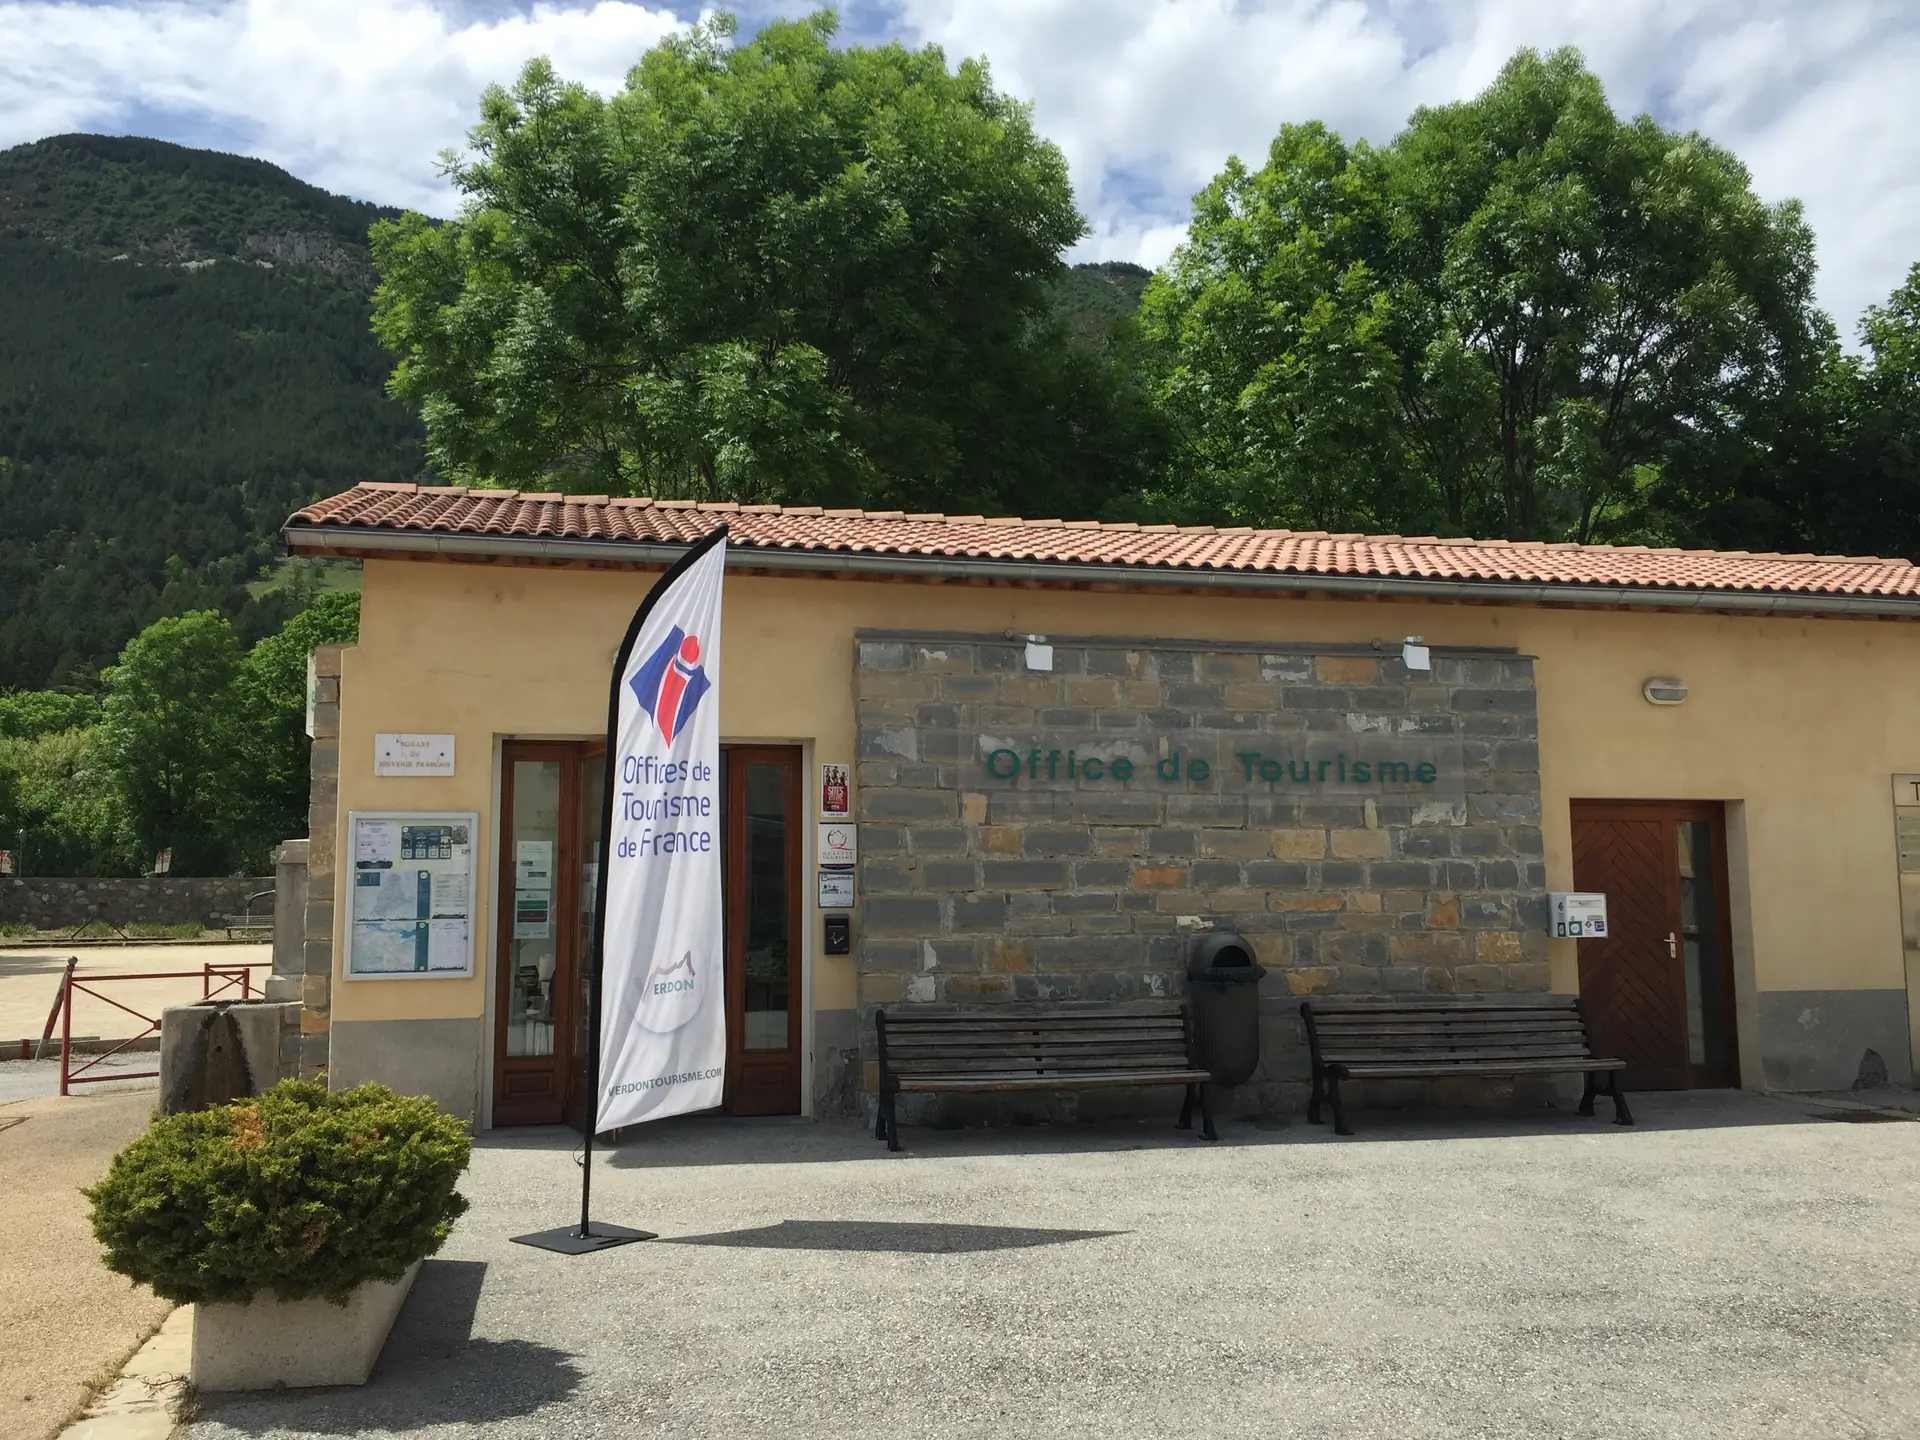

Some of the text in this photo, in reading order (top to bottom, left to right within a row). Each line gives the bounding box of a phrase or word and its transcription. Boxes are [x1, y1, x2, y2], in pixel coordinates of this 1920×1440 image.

[623, 755, 711, 785] Offices de
[987, 749, 1438, 784] Office de Tourisme
[622, 791, 711, 821] Tourisme
[617, 828, 711, 858] de France
[608, 1067, 723, 1097] VERDONTOURISME.COM
